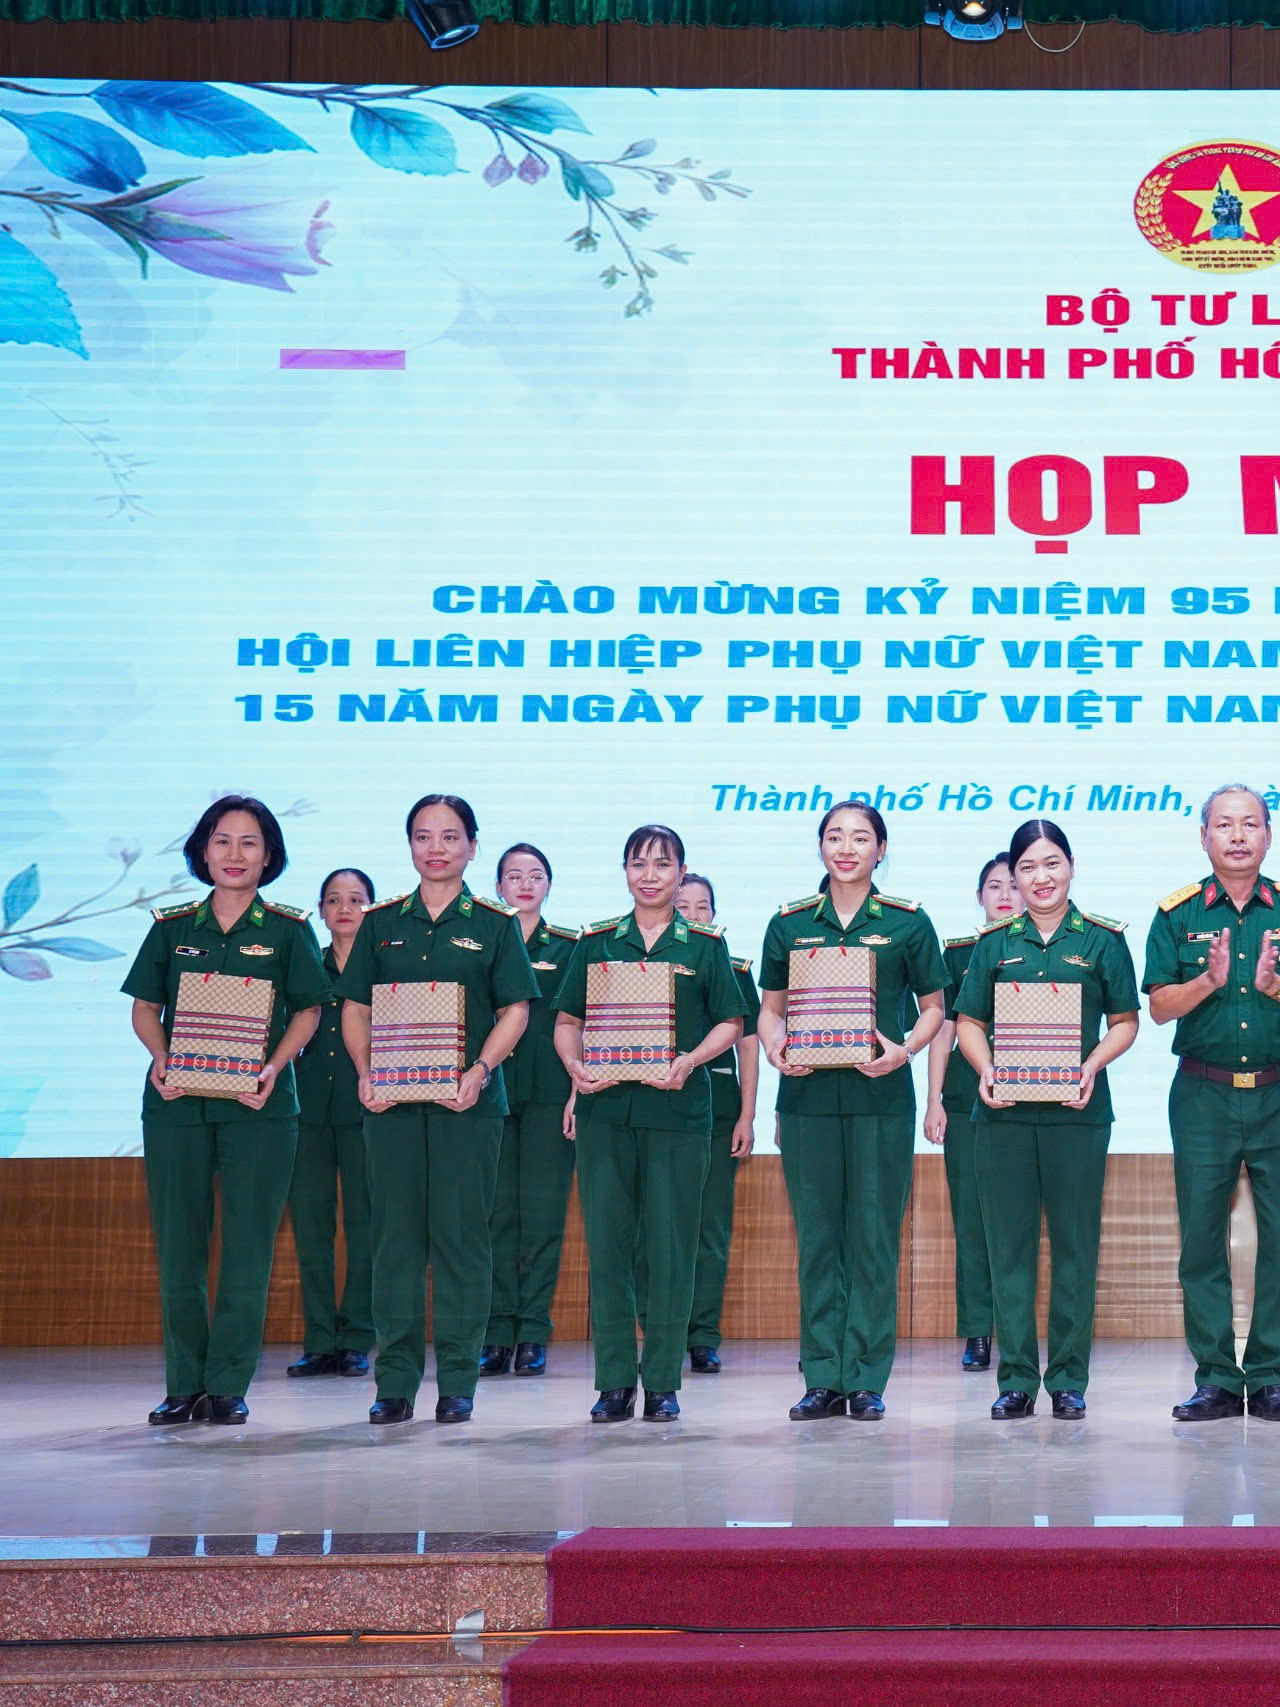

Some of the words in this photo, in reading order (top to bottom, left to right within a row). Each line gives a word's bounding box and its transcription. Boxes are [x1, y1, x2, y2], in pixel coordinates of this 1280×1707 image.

[1046, 287, 1130, 333] BỘ
[1151, 290, 1236, 326] TƯ
[831, 341, 1045, 379] THÀNH
[1068, 336, 1197, 379] PHỐ
[911, 454, 1189, 554] HỌP
[432, 579, 615, 615] CHÀO
[638, 580, 840, 615] MỪNG
[865, 577, 949, 615] KỶ
[971, 581, 1145, 621] NIỆM
[1170, 586, 1251, 615] 95
[236, 631, 351, 674] HỘI
[375, 633, 525, 668] LIÊN
[548, 633, 703, 675] HIỆP
[727, 639, 862, 675] PHỤ
[884, 634, 985, 669] NỮ
[1000, 634, 1143, 675] VIỆT
[234, 694, 315, 723] 15
[337, 687, 499, 723] NĂM
[521, 688, 705, 723] NGÀY
[727, 695, 861, 730] PHỤ
[887, 689, 987, 724] NỮ
[1000, 689, 1143, 730] VIỆT
[711, 783, 833, 812] Thành
[937, 782, 993, 812] Hồ
[1008, 784, 1077, 812] Chí
[1087, 784, 1193, 817] Minh,
